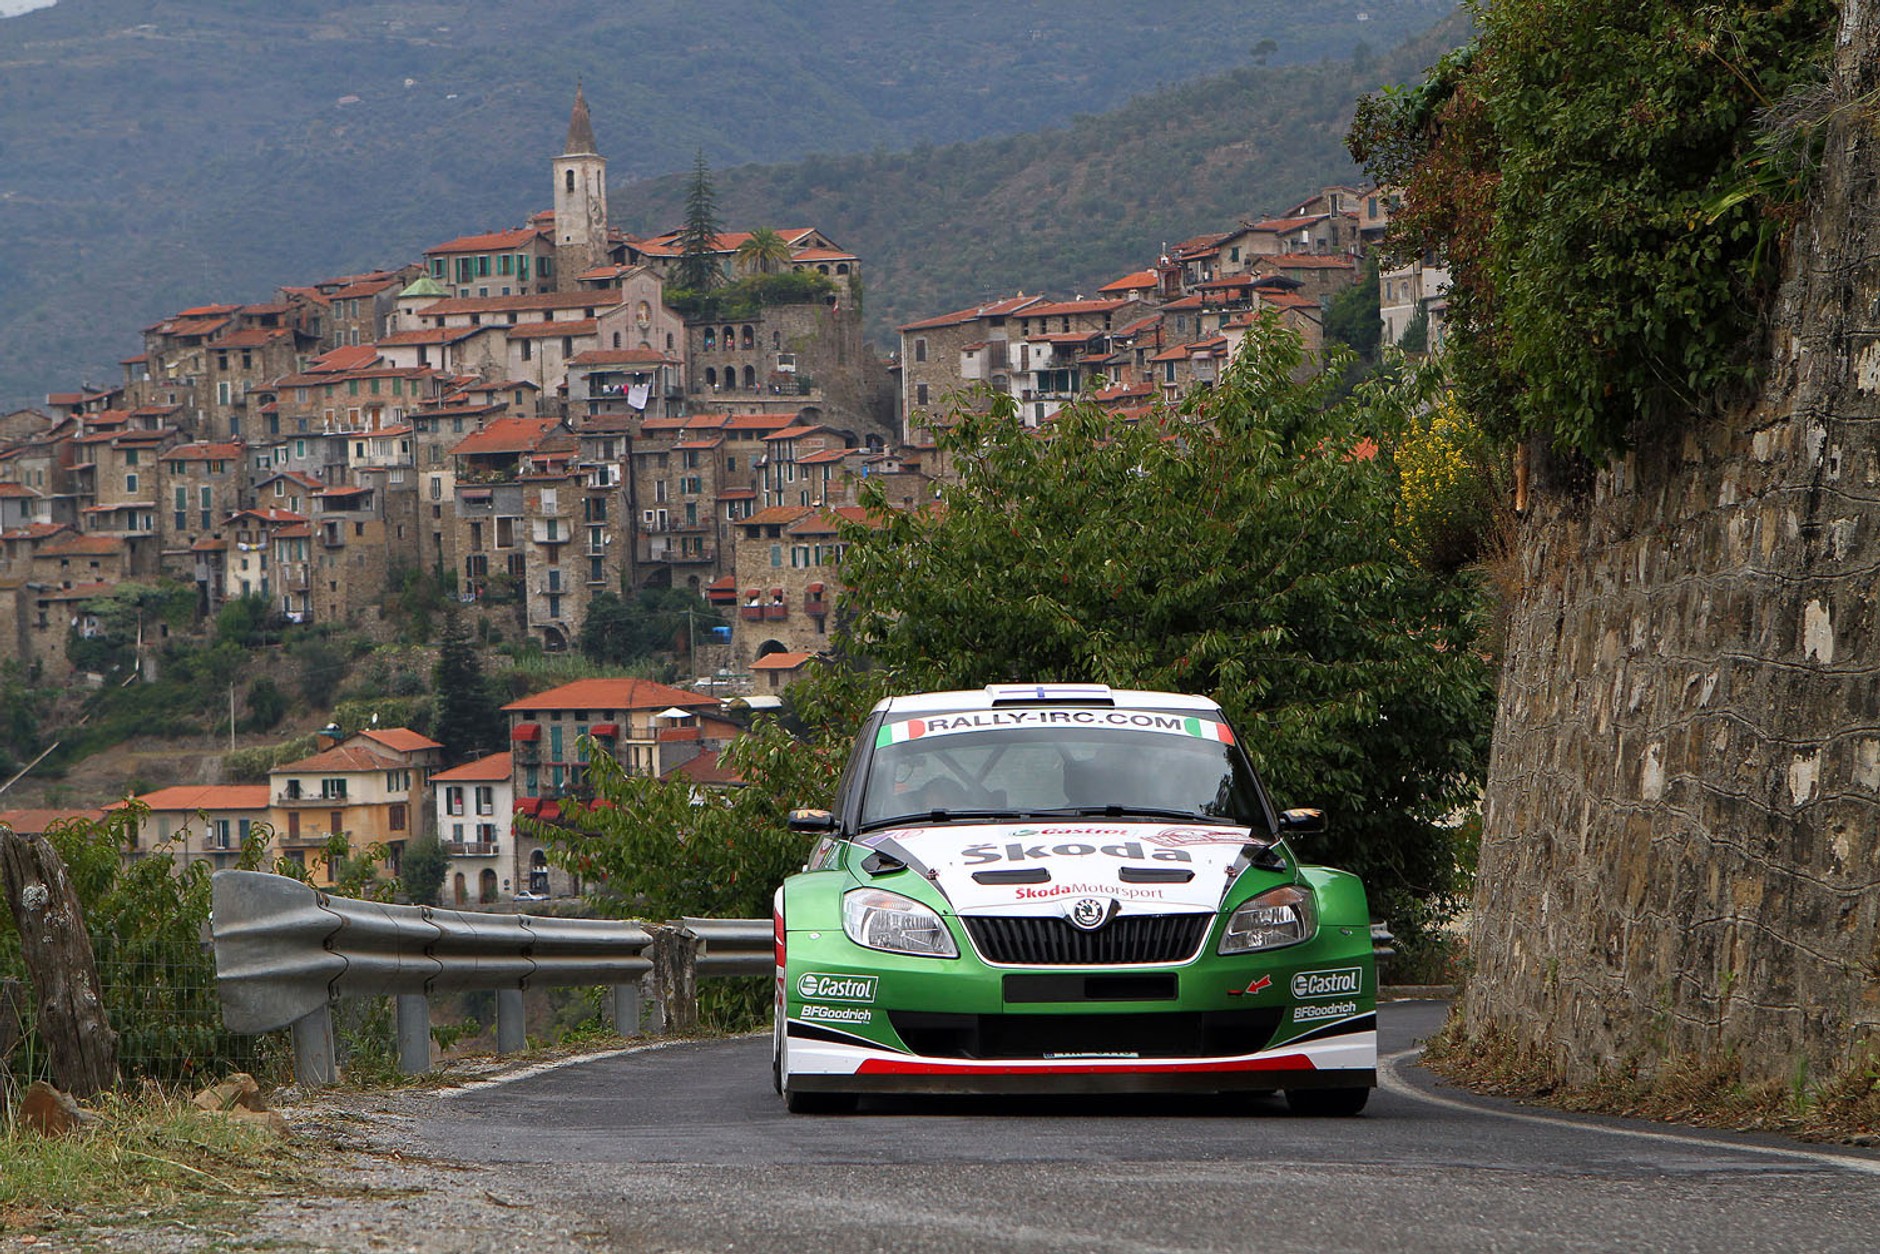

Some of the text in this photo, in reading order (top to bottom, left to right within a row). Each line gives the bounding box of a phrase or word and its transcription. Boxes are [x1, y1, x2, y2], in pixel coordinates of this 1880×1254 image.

[927, 711, 1183, 732] RALLY-IRC.COM
[961, 841, 1192, 865] Škoda
[818, 976, 872, 998] Castrol
[1308, 971, 1357, 994] Castrol
[800, 1004, 872, 1021] BFGoodrich
[1293, 1000, 1357, 1019] BFGoodrich
